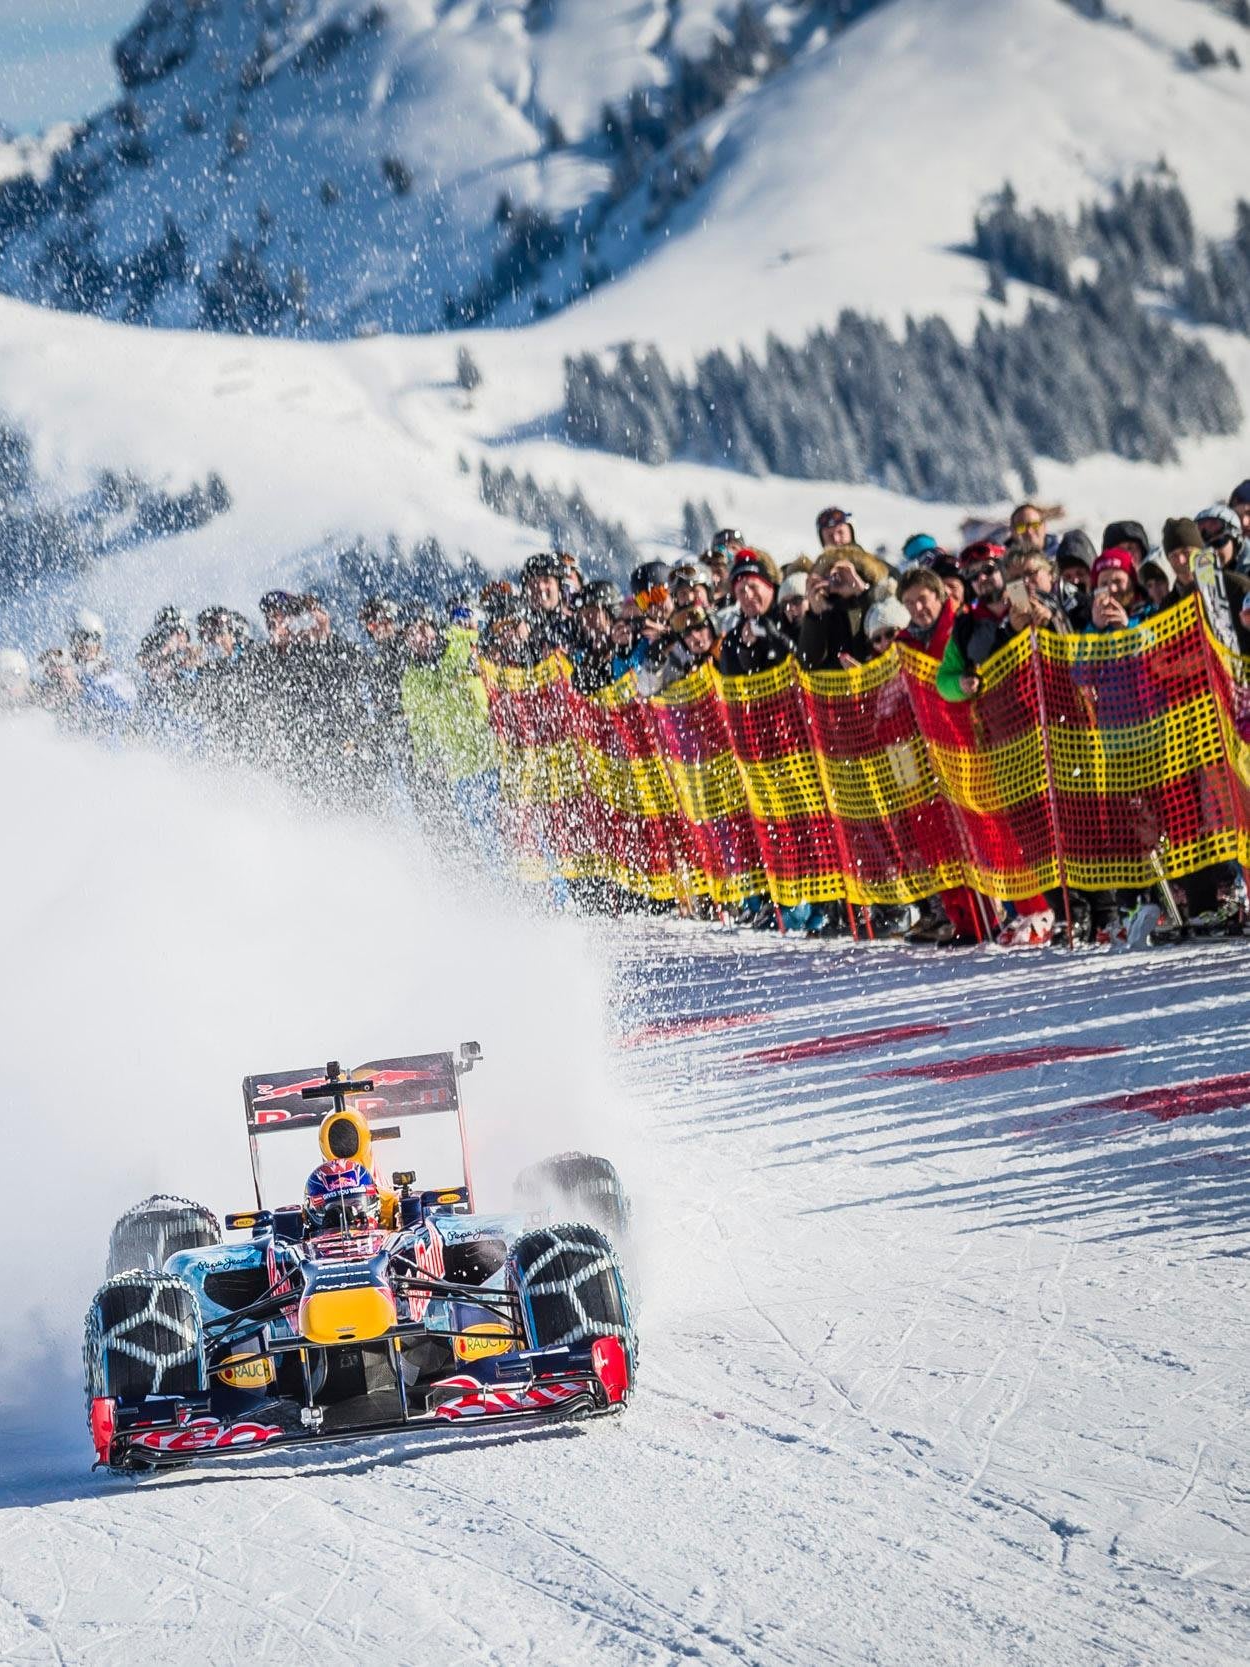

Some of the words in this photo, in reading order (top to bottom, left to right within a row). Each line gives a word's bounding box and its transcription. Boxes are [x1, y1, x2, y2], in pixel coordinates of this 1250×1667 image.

[447, 1230, 473, 1242] Pepe
[197, 1261, 223, 1272] Pepe
[223, 1258, 255, 1270] Jeans
[234, 1361, 271, 1378] RAUCH
